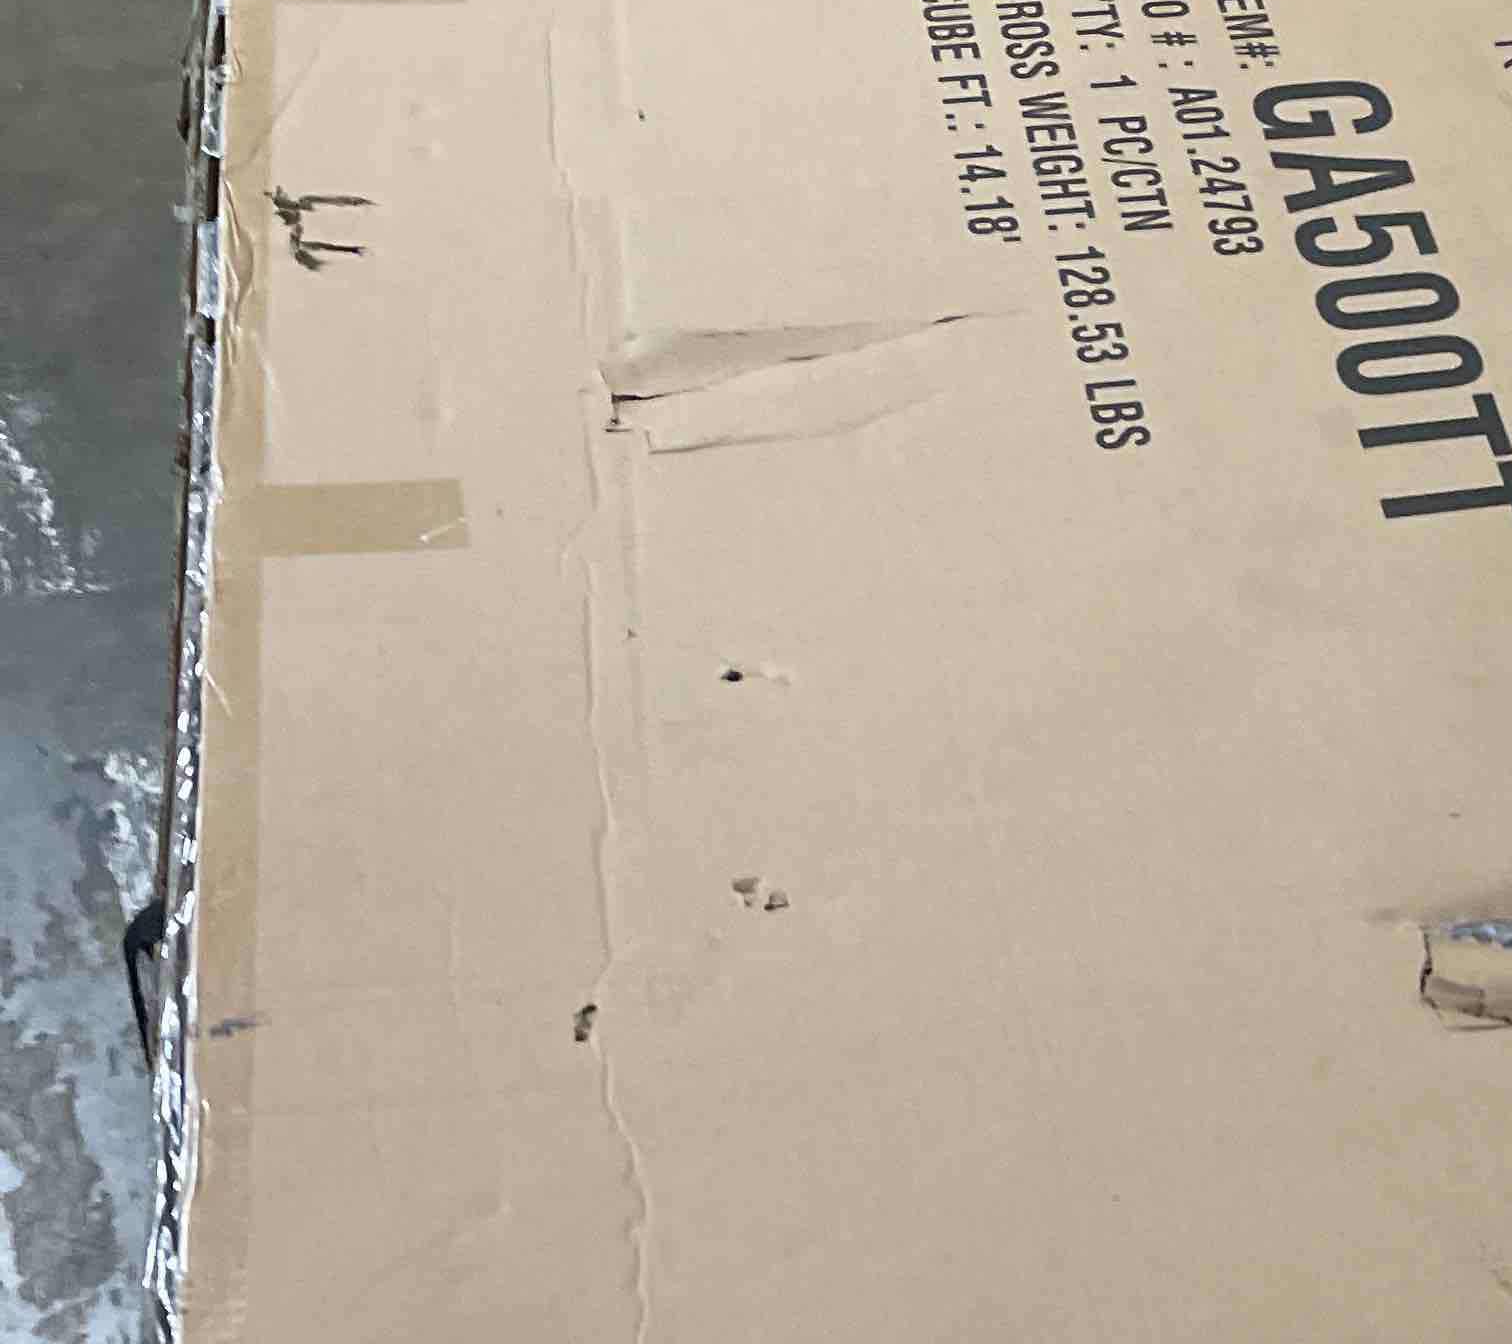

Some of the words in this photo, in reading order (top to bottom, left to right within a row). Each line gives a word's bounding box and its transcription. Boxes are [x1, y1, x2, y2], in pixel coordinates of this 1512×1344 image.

[1090, 74, 1137, 90] 1
[1018, 91, 1096, 232] WEIGHT:
[1098, 114, 1173, 233] PC/CTN
[1168, 87, 1264, 256] A01.24793
[1054, 246, 1129, 365] 128.53
[1084, 380, 1151, 450] LBS
